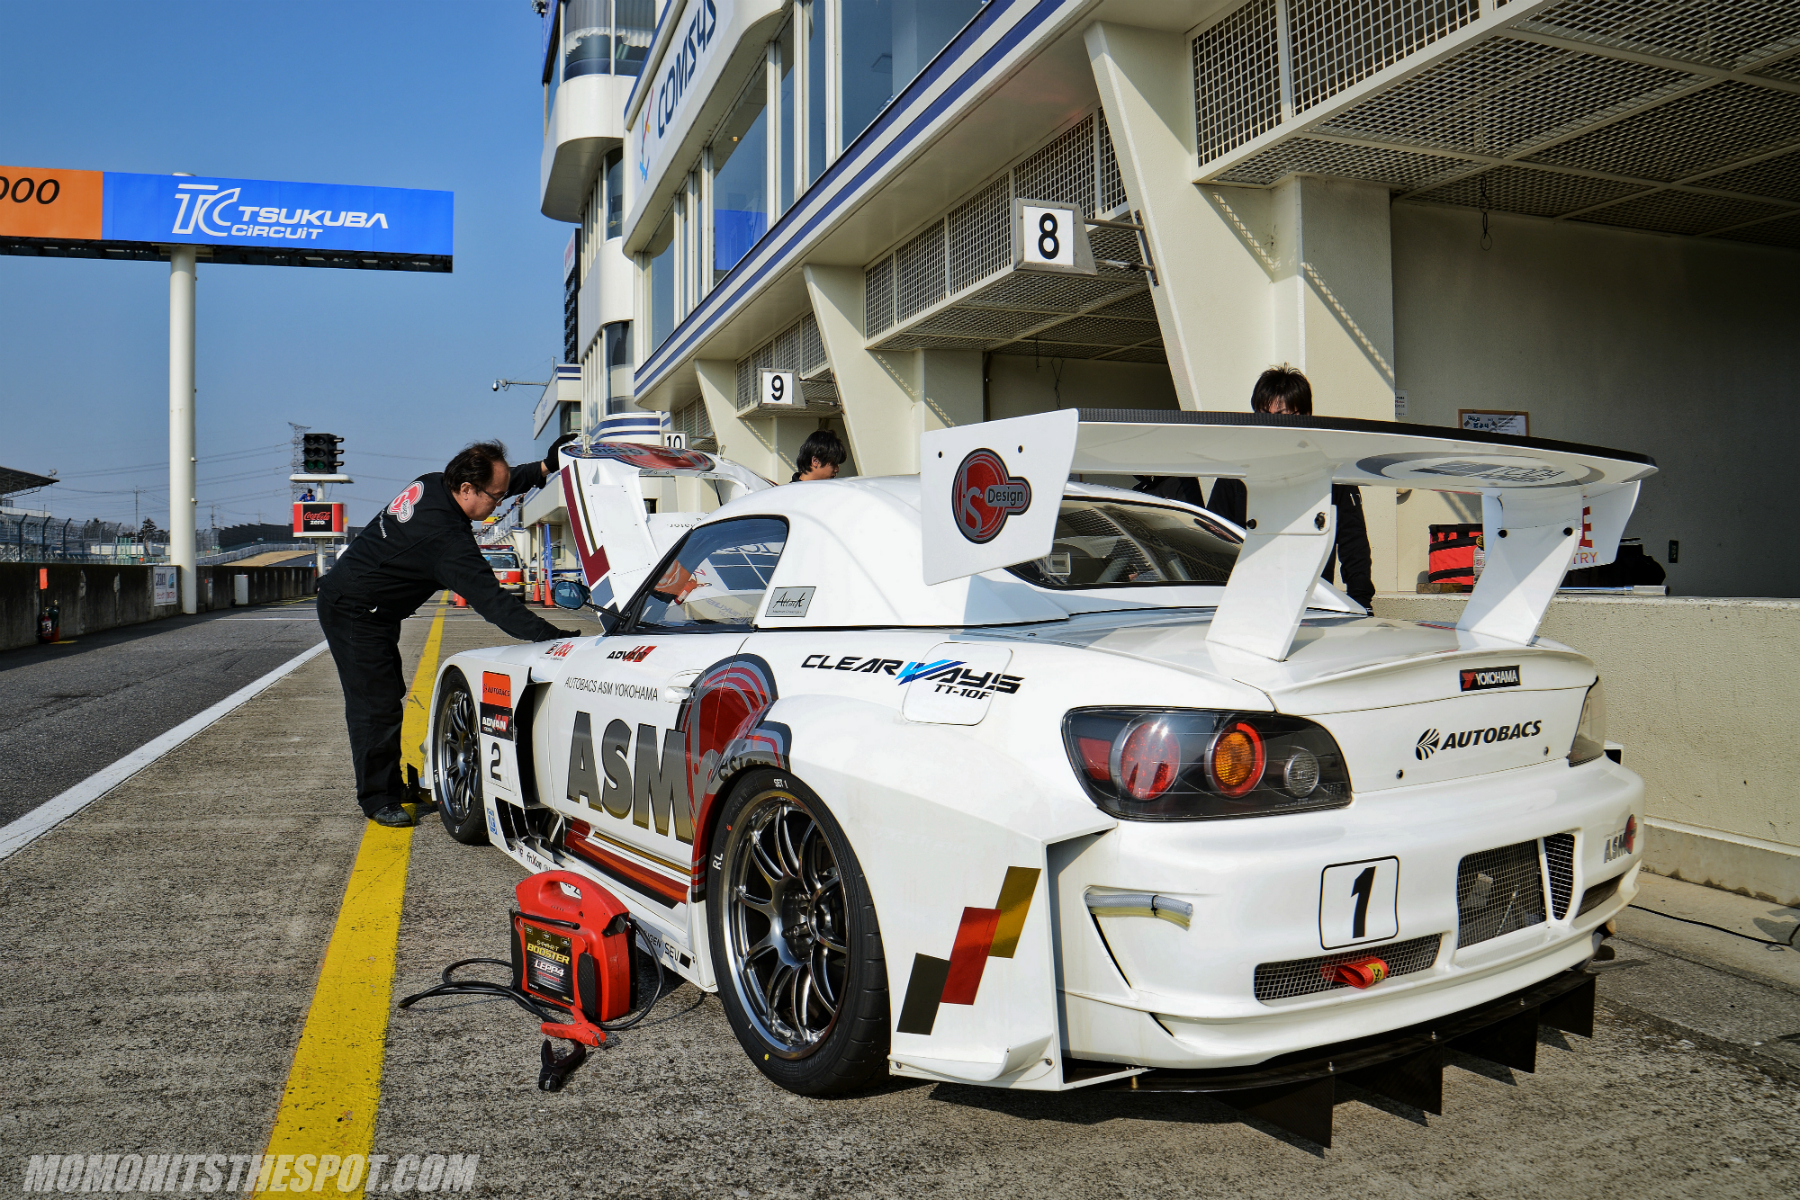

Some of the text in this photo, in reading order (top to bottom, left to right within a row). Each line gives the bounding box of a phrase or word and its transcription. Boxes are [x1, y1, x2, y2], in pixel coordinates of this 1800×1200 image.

[238, 205, 389, 229] TSUKUBA
[1038, 212, 1060, 260] 8
[771, 374, 785, 402] 9
[667, 435, 682, 449] 10
[988, 486, 1024, 506] Design
[607, 648, 652, 662] ADVAN
[1475, 670, 1518, 686] YOKOHAMA
[488, 687, 510, 697] AUTOBACS
[564, 677, 658, 702] AUTOBACS ASM YOKOHAMA
[934, 683, 992, 700] TT-10F
[482, 716, 507, 731] ADVAN
[1440, 719, 1542, 750] AUTOBACS
[490, 742, 502, 781] 2
[567, 710, 695, 846] ASM
[713, 853, 724, 871] RL
[1350, 866, 1377, 939] 1
[527, 942, 570, 965] BOOSTER
[664, 942, 680, 961] SEV
